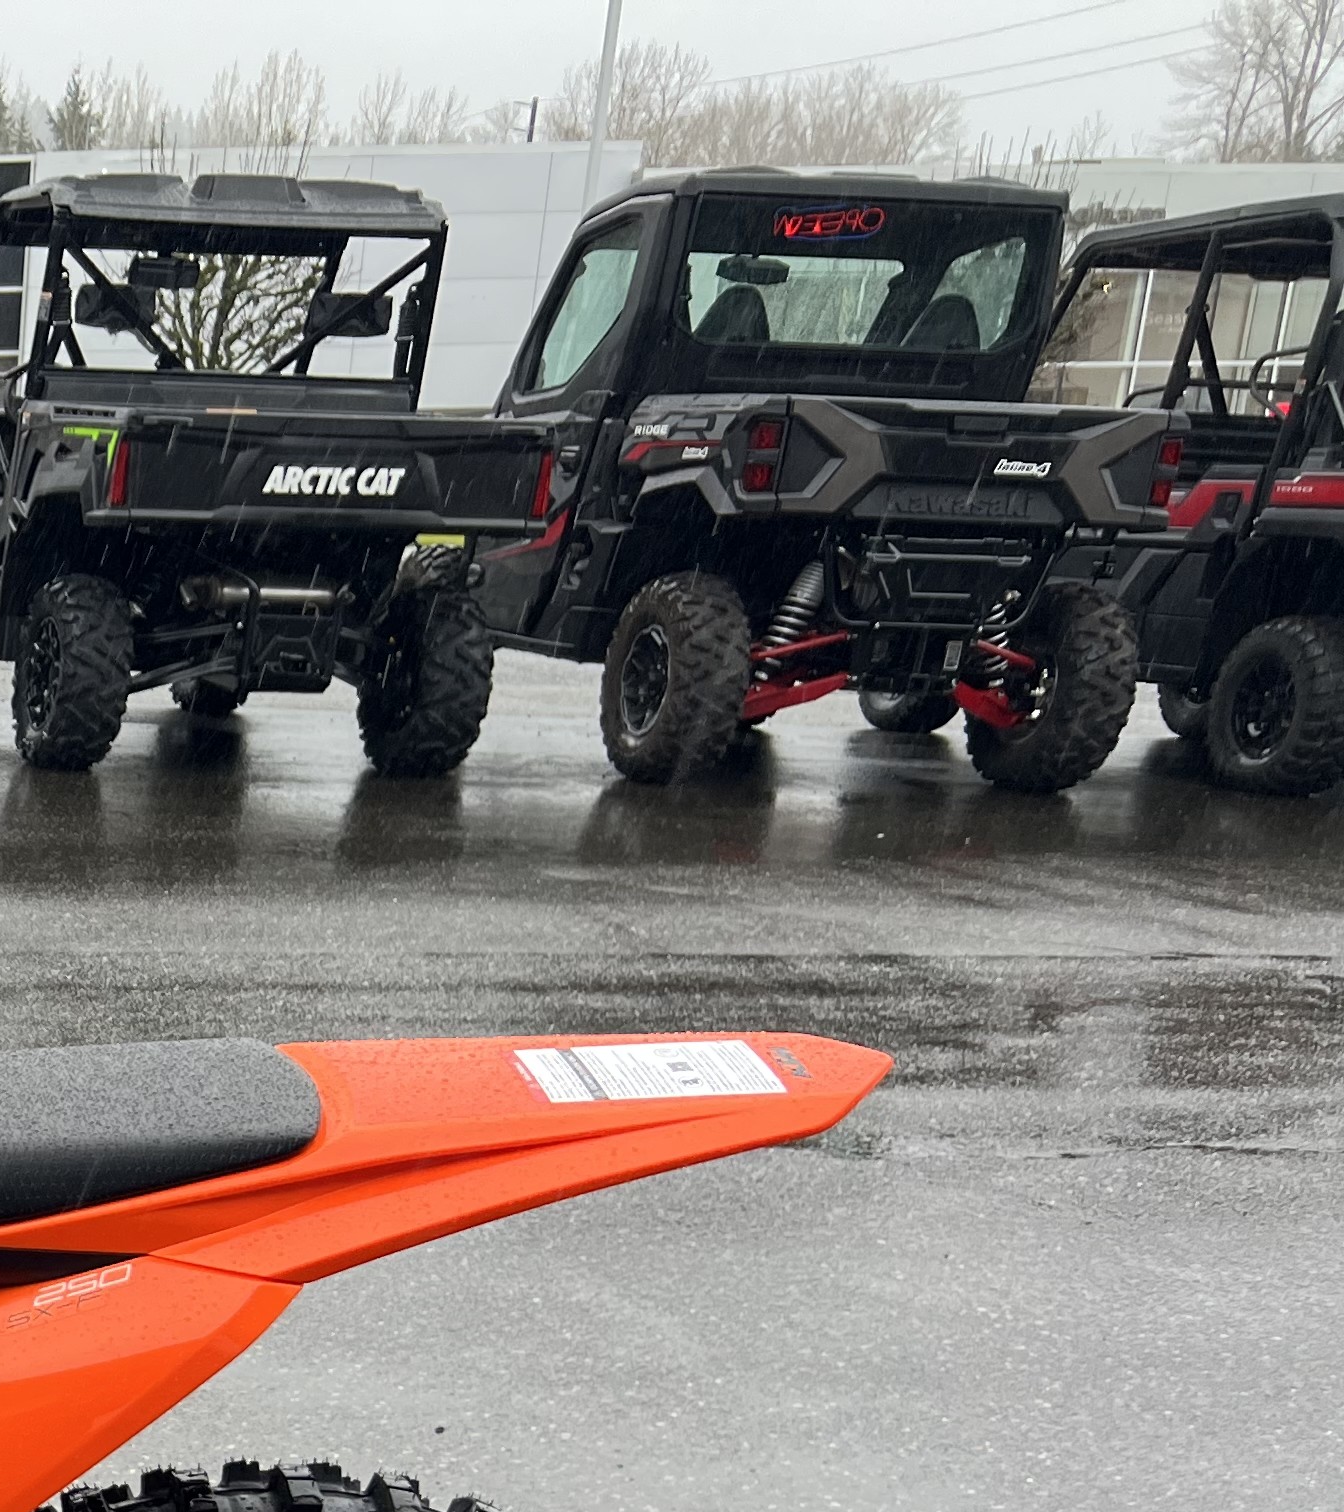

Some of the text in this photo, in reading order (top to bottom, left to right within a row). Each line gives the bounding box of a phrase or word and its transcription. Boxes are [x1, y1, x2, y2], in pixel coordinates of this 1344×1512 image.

[634, 424, 669, 436] RIDGE
[262, 465, 406, 497] ARCTIC CAT
[33, 1263, 131, 1307] 250
